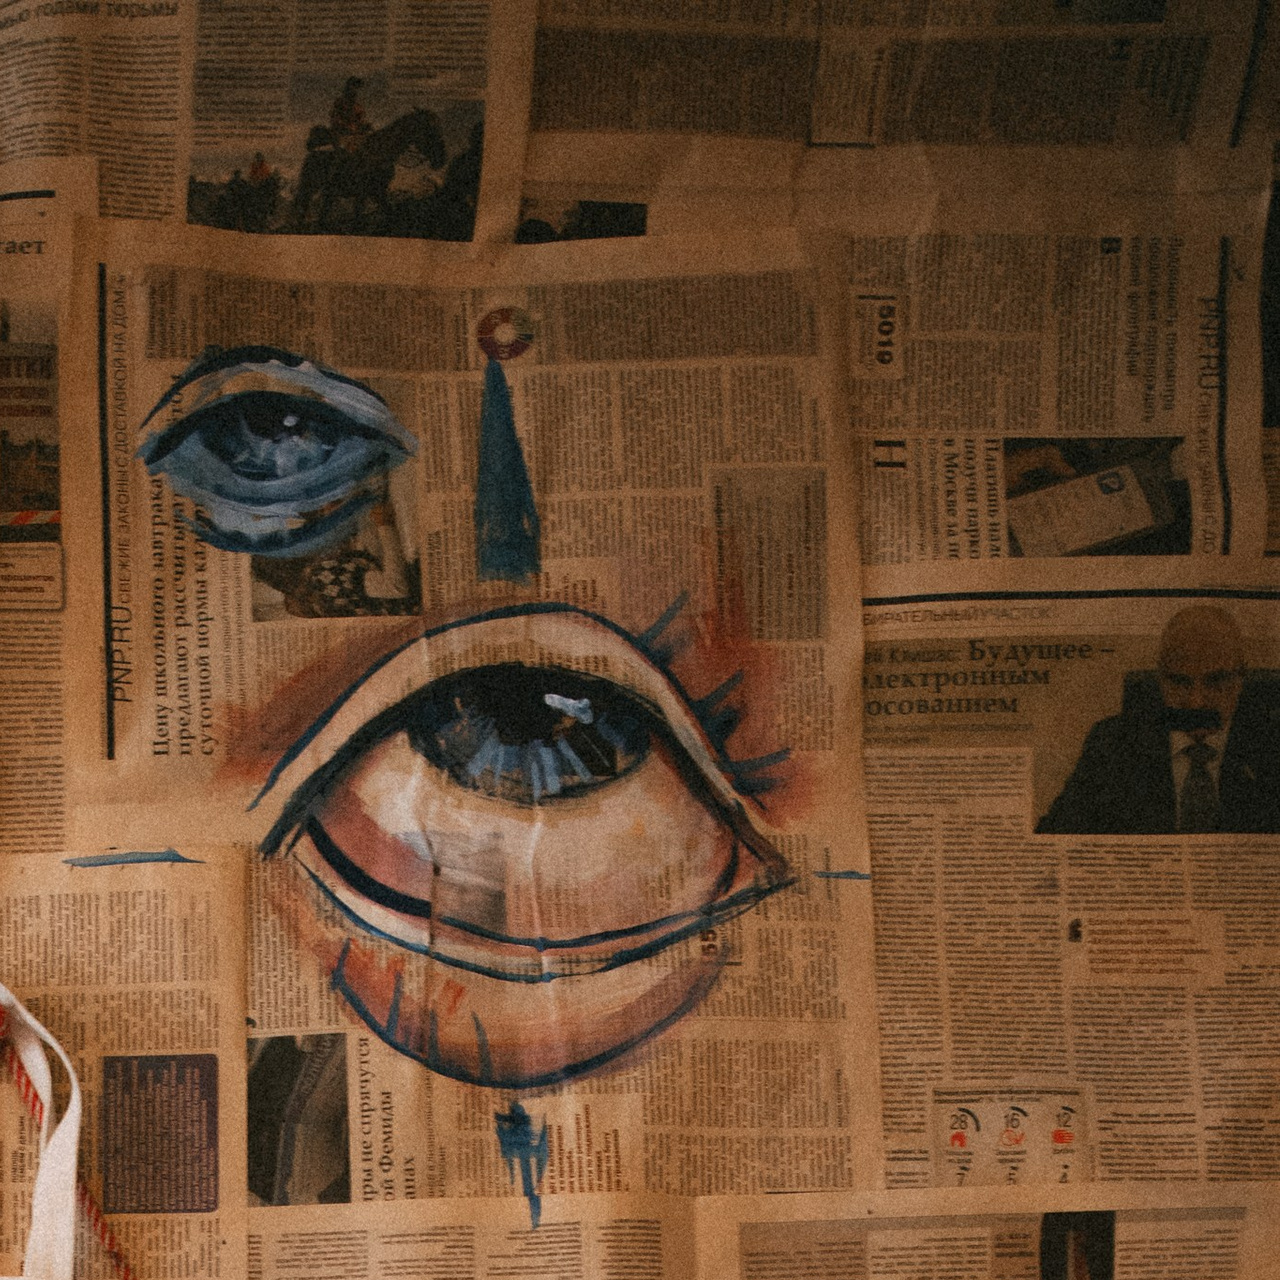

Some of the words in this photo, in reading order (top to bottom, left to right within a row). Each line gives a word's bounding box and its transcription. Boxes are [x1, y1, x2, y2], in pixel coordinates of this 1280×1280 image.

[113, 290, 130, 329] ДОМ
[115, 332, 128, 354] НА
[112, 357, 130, 455] ДОСТАВКОЙ
[943, 452, 962, 518] Москве
[961, 438, 980, 504] получи
[984, 438, 1001, 518] Платишь
[147, 476, 171, 571] завтрака
[943, 522, 961, 537] за
[117, 538, 133, 605] СВЕЖИЕ
[149, 577, 169, 698] школьного
[193, 579, 214, 650] нормы
[863, 669, 1050, 692] лектронным
[968, 639, 1093, 667] Будущее
[173, 635, 195, 757] предлагают
[196, 654, 216, 757] суточной
[151, 703, 176, 757] Цену
[357, 1037, 376, 1135] спрячутся
[361, 1140, 372, 1163] не
[378, 1090, 395, 1174] Фемиды
[949, 1114, 968, 1131] 28
[1004, 1113, 1020, 1129] 16
[1056, 1112, 1072, 1128] 12
